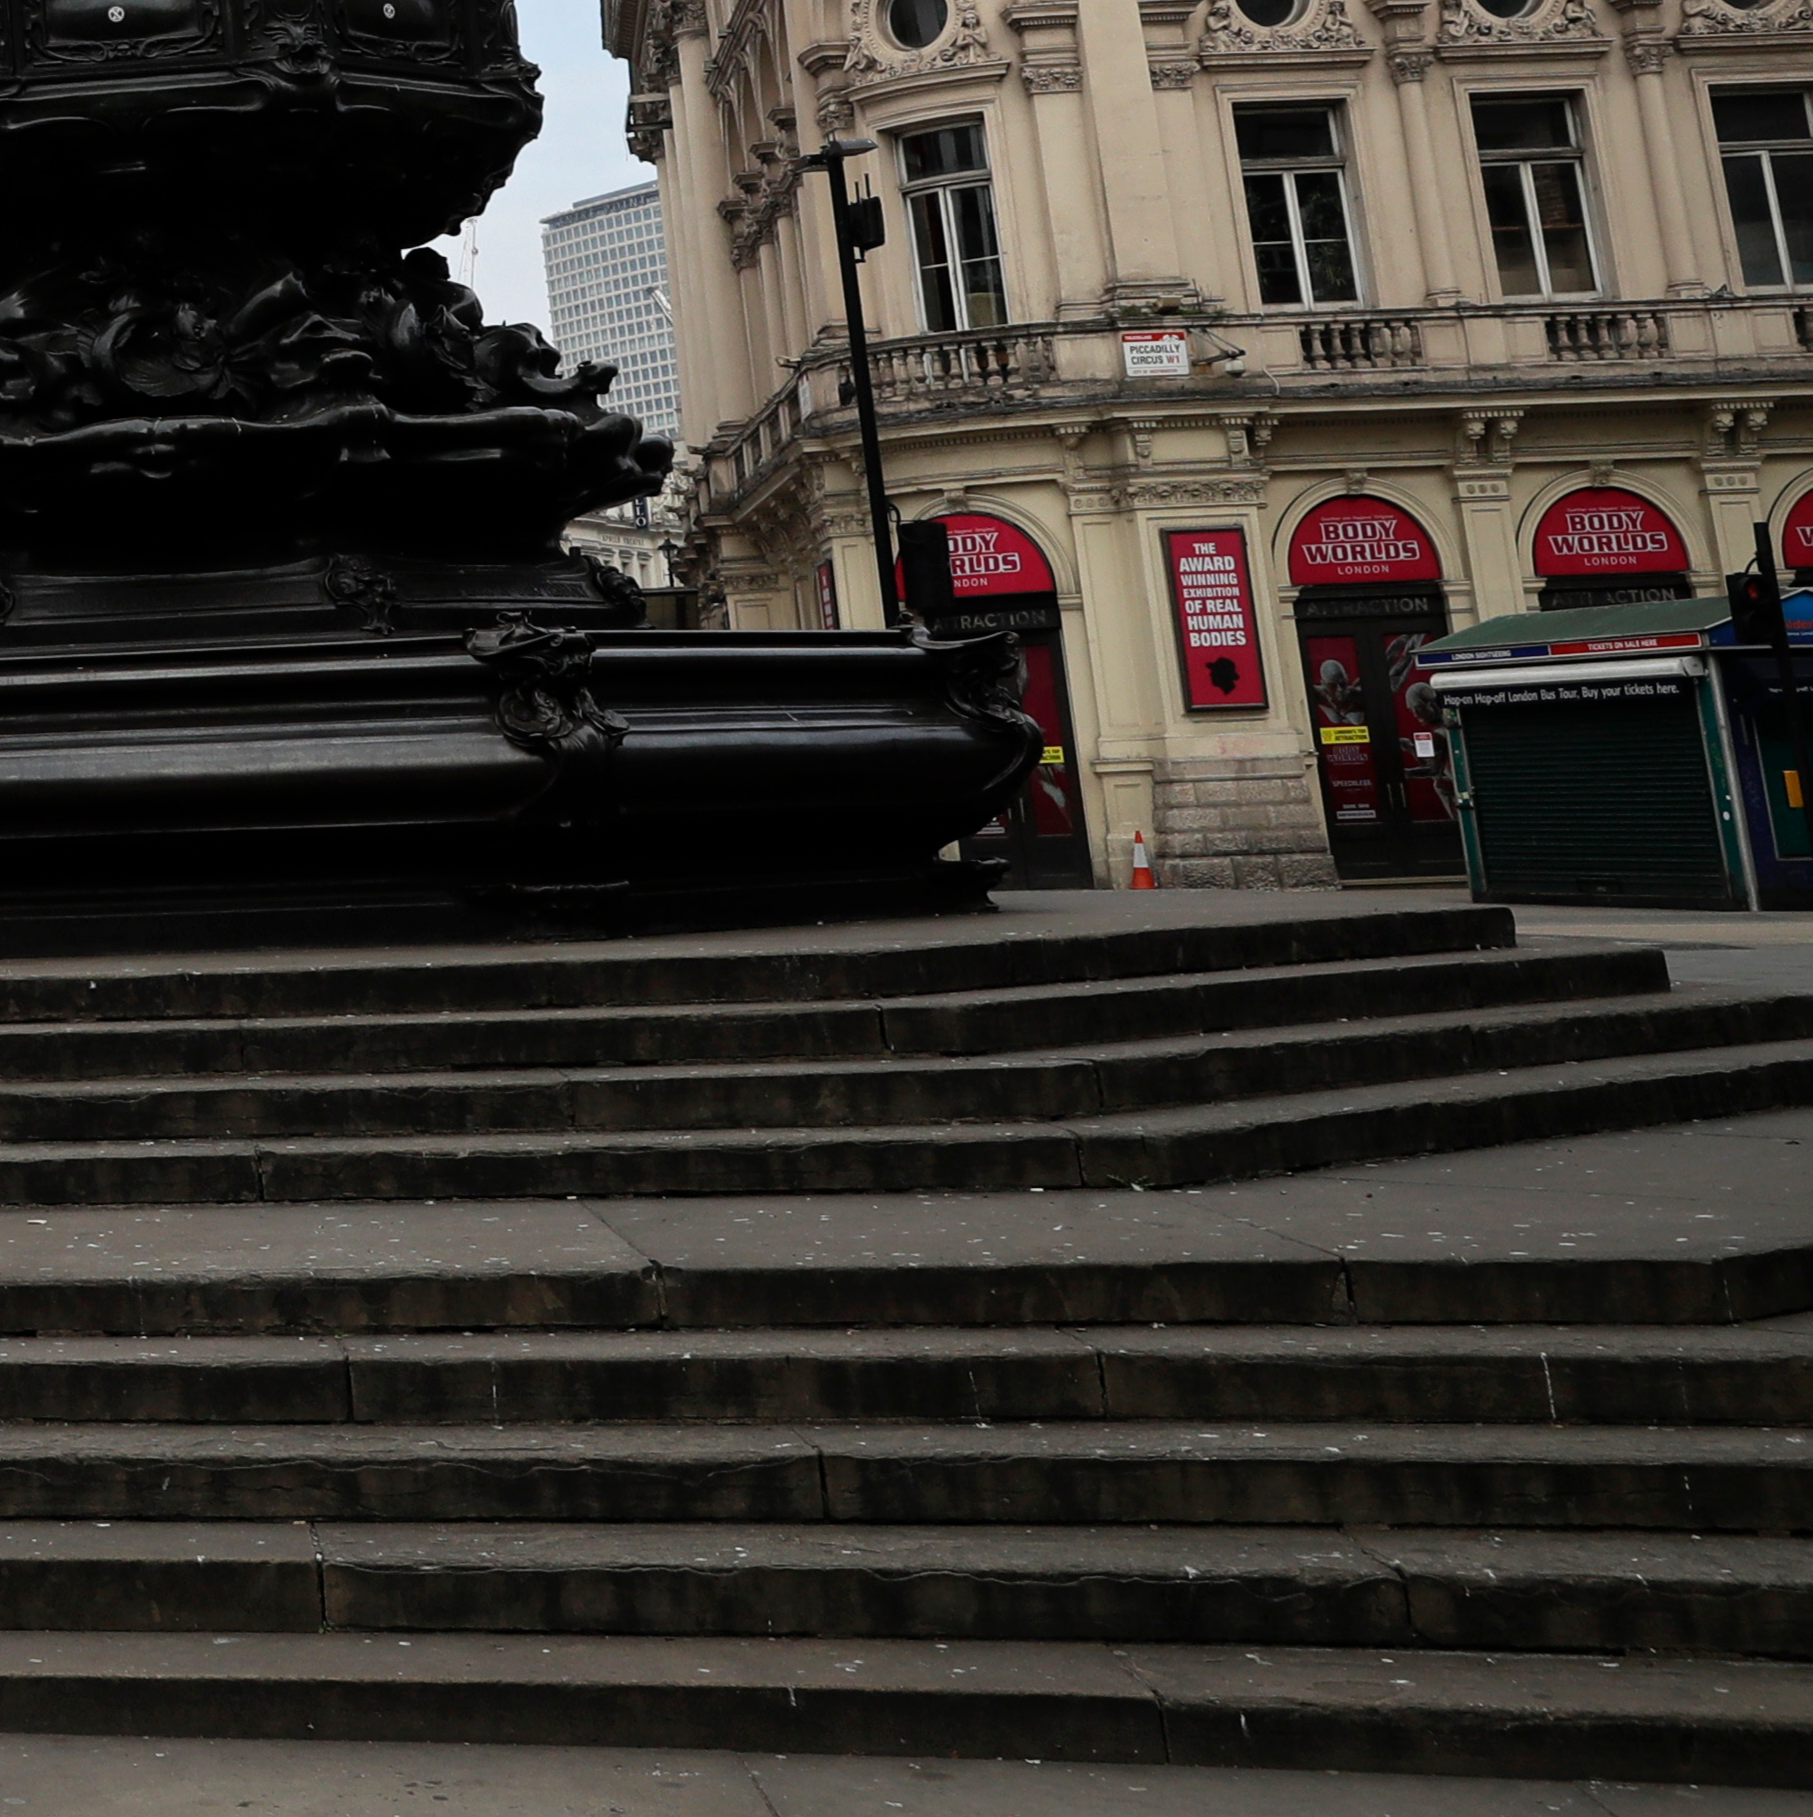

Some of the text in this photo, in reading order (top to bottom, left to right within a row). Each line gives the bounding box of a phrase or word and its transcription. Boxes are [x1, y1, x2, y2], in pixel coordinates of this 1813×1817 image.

[1129, 344, 1180, 354] PICCADILLY
[1131, 355, 1180, 365] CIRCUS W1
[635, 498, 646, 527] LLO
[1565, 511, 1644, 533] BODY
[1320, 520, 1397, 542] BODY
[947, 532, 999, 554] ODY
[1193, 542, 1216, 554] THE
[1548, 532, 1668, 555] WORLDS
[1302, 540, 1420, 565] WORLDS
[949, 552, 1021, 576] RLDS
[1179, 556, 1235, 572] AWARD
[1584, 556, 1637, 566] LONDON
[1337, 564, 1390, 575] LONDON
[953, 577, 988, 588] NDON
[1180, 573, 1238, 586] WINNING
[1183, 587, 1240, 598] EXHIBITION
[1552, 587, 1675, 606] ATTACTION
[1185, 599, 1242, 613] OF REAL
[1187, 614, 1244, 630] HUMAN
[1189, 631, 1247, 647] BODIES
[1587, 638, 1658, 650] TICKETS ON SALE HERE
[1451, 651, 1475, 661] LONDON
[1444, 695, 1473, 706] Hop-on
[1475, 692, 1505, 705] Hop-off
[1508, 691, 1538, 703] London
[1540, 689, 1556, 700] Bus
[1581, 687, 1598, 699] Buy
[1601, 687, 1621, 699] your
[1624, 683, 1654, 695] tickets
